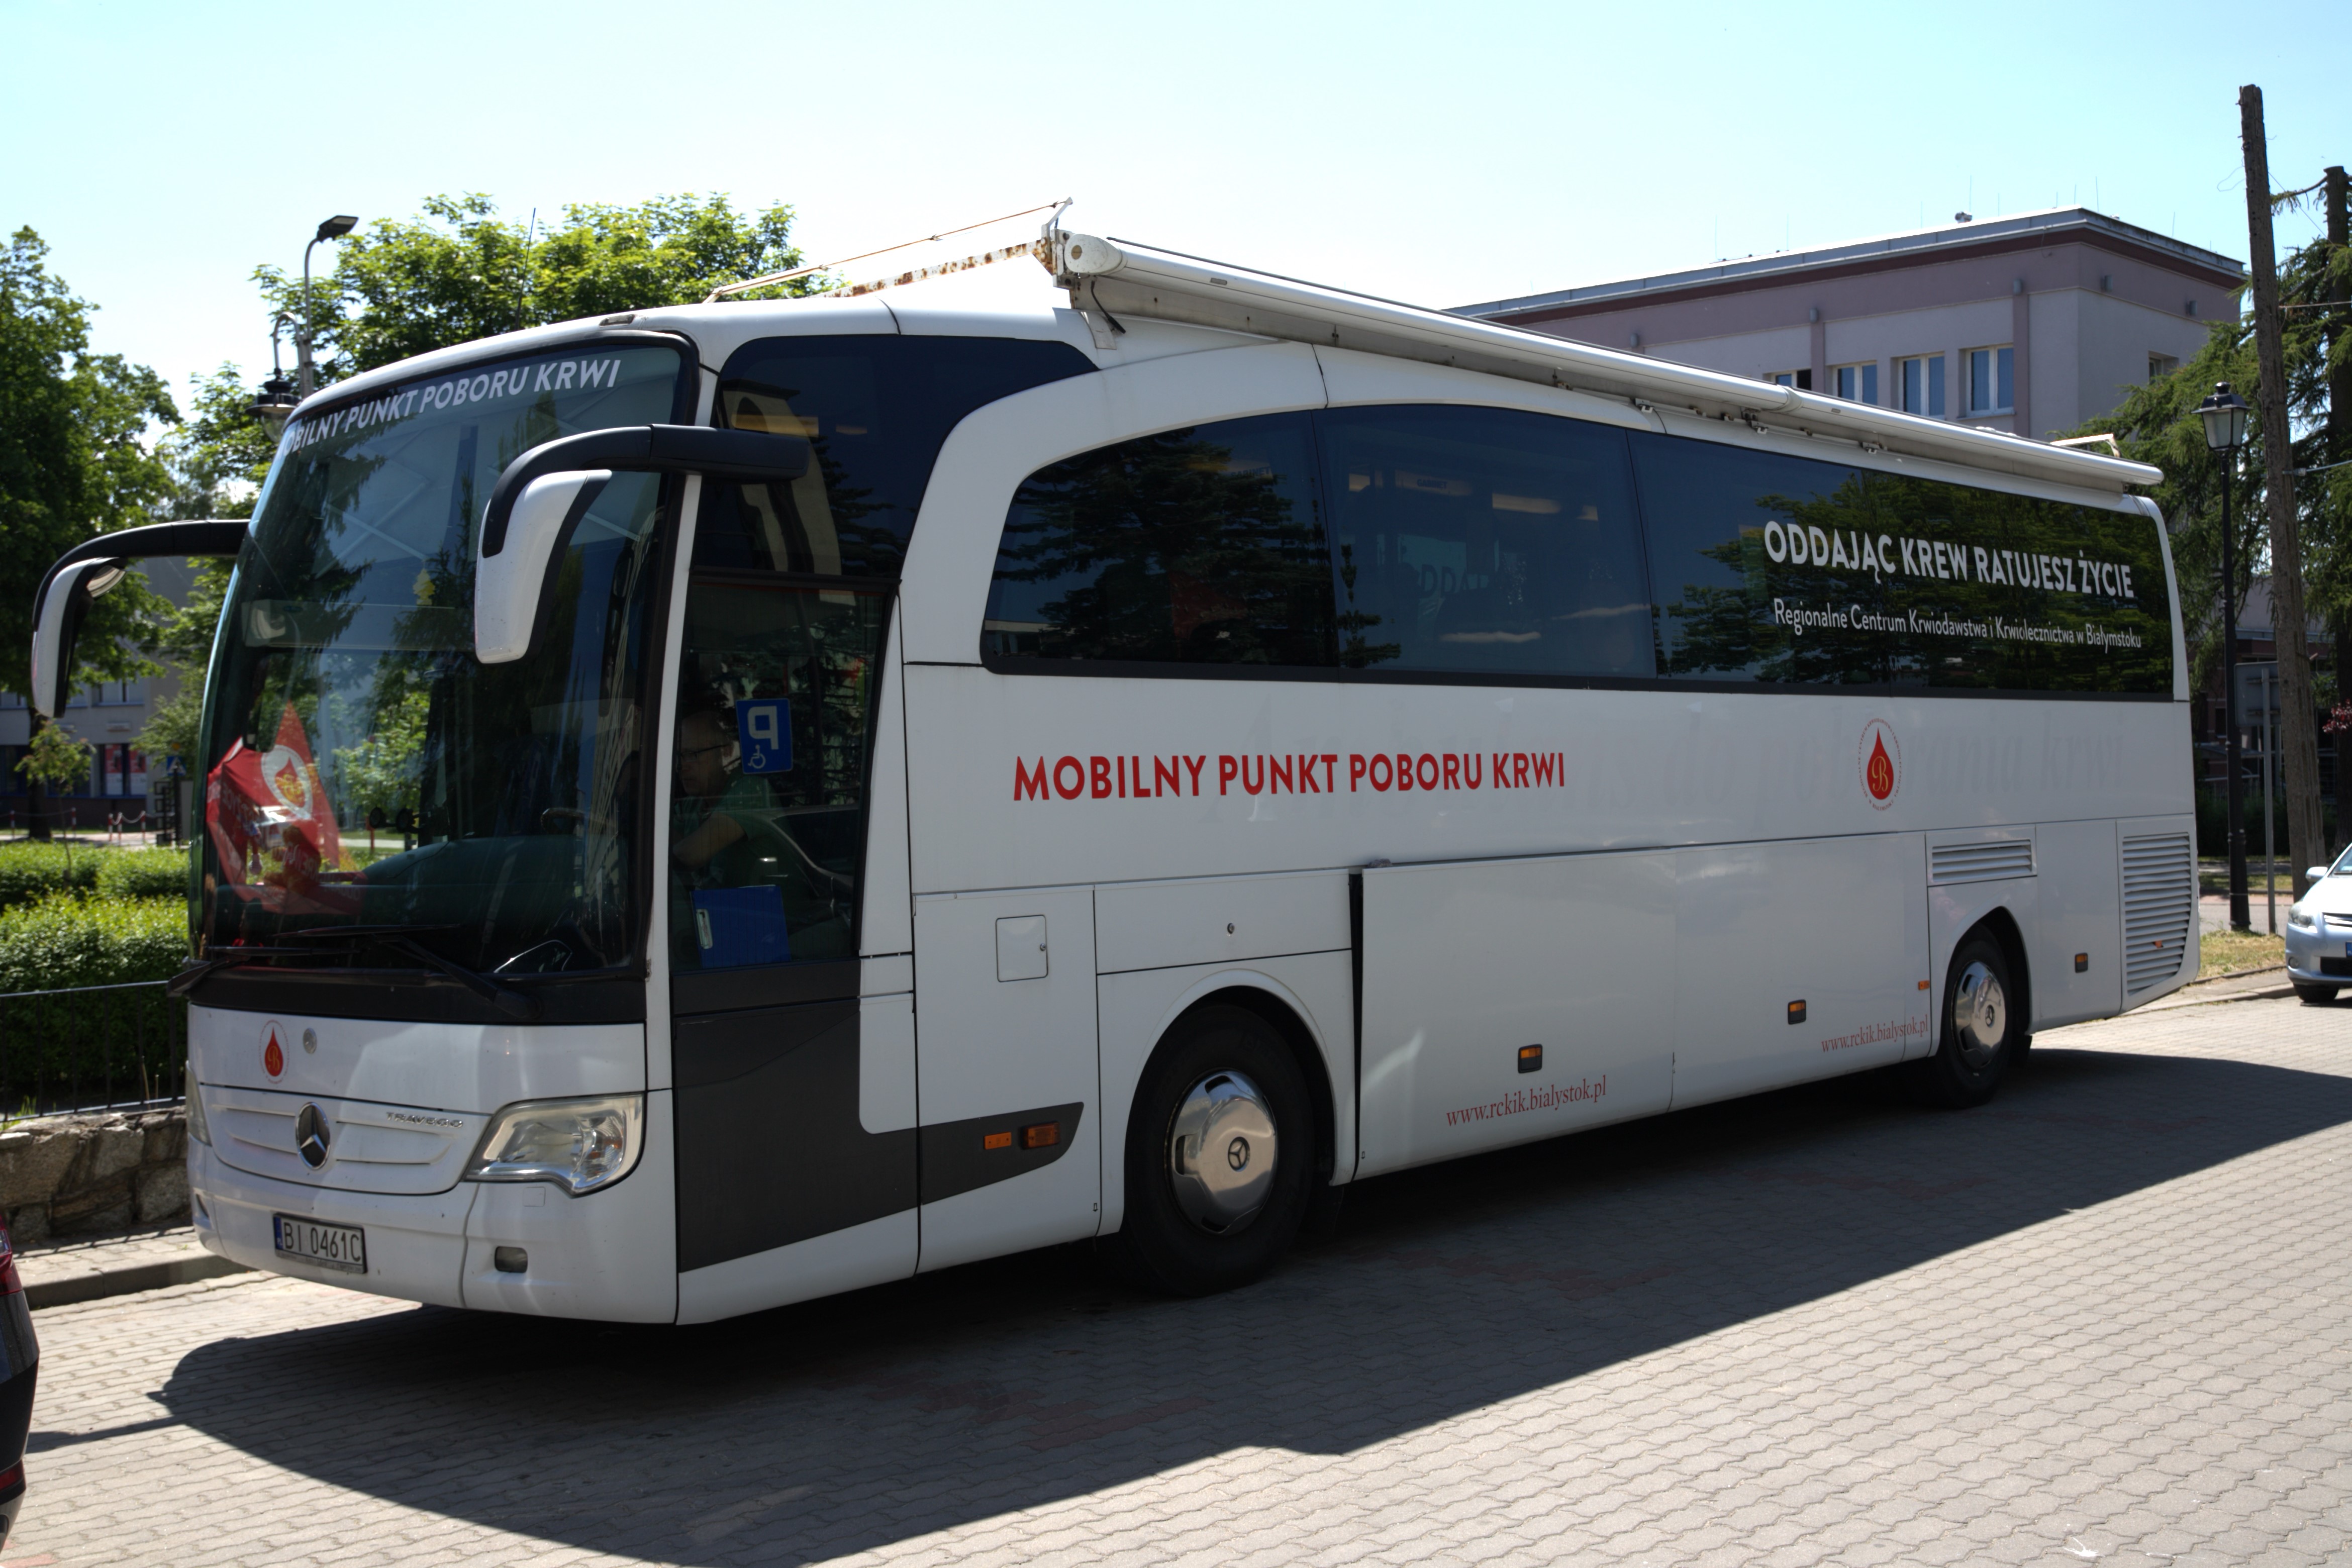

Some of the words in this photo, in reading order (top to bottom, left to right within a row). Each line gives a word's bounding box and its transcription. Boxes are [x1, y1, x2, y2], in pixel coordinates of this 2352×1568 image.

[283, 410, 346, 456] OBILNY
[344, 389, 418, 433] PUNKT
[419, 366, 529, 414] POBORU
[534, 359, 621, 392] KRWI
[1765, 521, 1896, 584] ODDAJĄC
[1900, 537, 1968, 580] KREW
[1973, 546, 2077, 592] RATUJESZ
[2078, 549, 2134, 598] ŻYCIE
[1774, 598, 1847, 636] Regionalne
[1850, 604, 1906, 632] Centrum
[1909, 608, 1987, 638] Krwiodawstwa
[1988, 616, 1993, 638] i
[1994, 616, 2075, 643] Krwiolecznictwa
[2076, 631, 2084, 644] w
[2086, 623, 2141, 654] Białymstoku
[1014, 755, 1207, 801] MOBILNY
[1219, 754, 1338, 796] PUNKT
[1349, 753, 1482, 792] POBORU
[1493, 752, 1564, 789] KRWI
[1821, 1014, 1928, 1053] www.rckik.bialystok.pl
[386, 1112, 463, 1128] TRAVEGO
[1446, 1074, 1606, 1127] www.rckik.bialystok.pl
[284, 1222, 302, 1252] BI
[310, 1227, 361, 1262] 0461C
